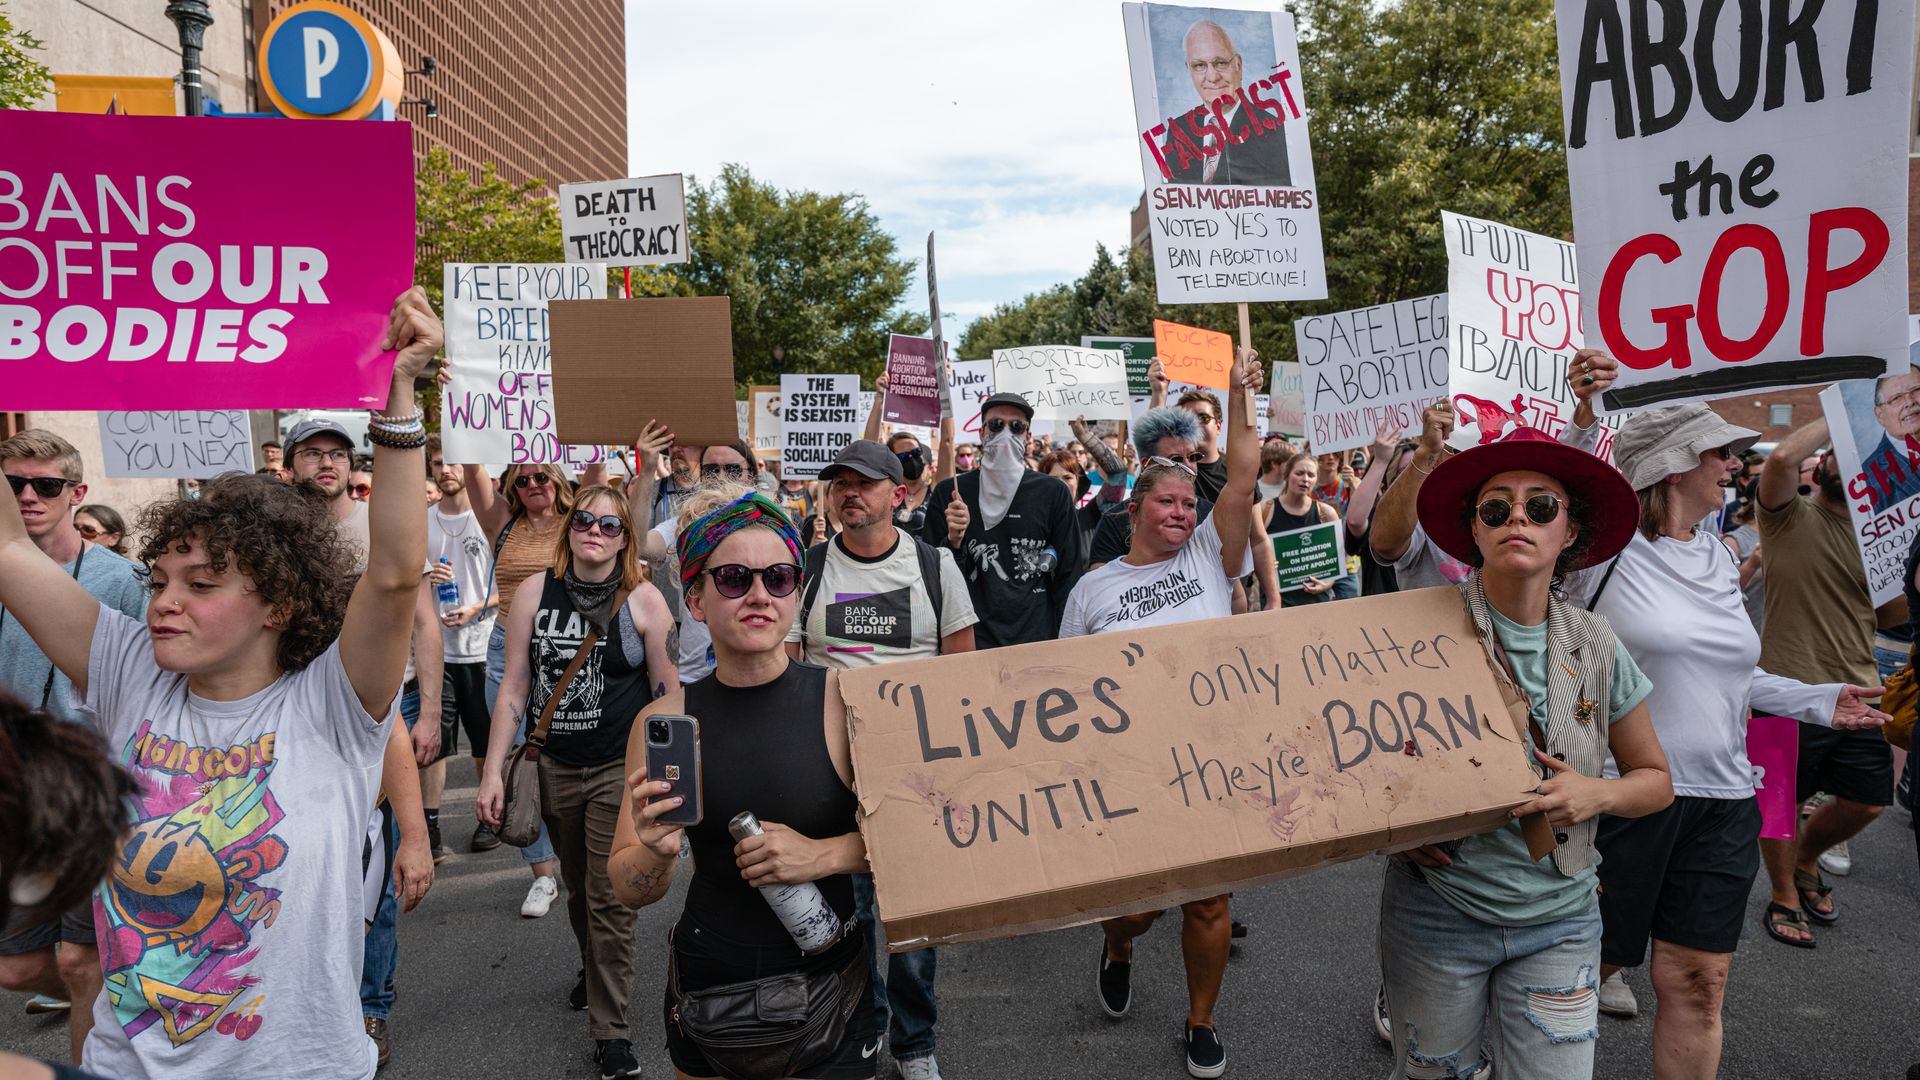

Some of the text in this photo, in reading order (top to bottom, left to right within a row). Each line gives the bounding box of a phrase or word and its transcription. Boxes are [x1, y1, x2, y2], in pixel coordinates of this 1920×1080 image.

[303, 27, 340, 99] P
[1142, 69, 1302, 180] FASCIST
[1153, 187, 1312, 210] SEN. MICHAEL NEMES
[1659, 153, 1780, 222] the
[0, 170, 196, 237] BANS
[575, 187, 656, 218] DEATH
[608, 216, 626, 226] TO
[1157, 211, 1297, 240] VOTED YES TO
[570, 224, 679, 259] THEOCRACY
[1457, 218, 1531, 271] PUT
[0, 237, 330, 304] OFF OUR
[1168, 247, 1297, 269] BAN ABORTION
[454, 265, 593, 301] KEEP YOUR
[1177, 270, 1307, 292] TELEMEDICINE!
[1598, 207, 1890, 370] GOP
[478, 308, 550, 341] BREED
[1390, 296, 1448, 350] LEG
[1487, 268, 1584, 352] YOU
[0, 304, 295, 364] BODIES
[1163, 324, 1221, 348] FUCK
[892, 364, 927, 376] ABORTION
[893, 353, 925, 365] BANNING
[996, 349, 1120, 369] ABORTION
[1459, 324, 1576, 407] BACK
[499, 370, 552, 396] OFF
[807, 378, 834, 391] THE
[890, 385, 939, 398] PREGNANCY
[891, 375, 936, 386] IS FORCING
[1046, 368, 1078, 387] IS
[1273, 365, 1303, 396] Man
[1313, 346, 1449, 411] ABORTIO
[449, 392, 550, 430] WOMENS
[791, 393, 850, 407] SYSTEM
[1021, 390, 1125, 408] EALTHCARE
[106, 409, 247, 439] COME FOR
[785, 409, 856, 423] IS SEXIST!
[1272, 401, 1304, 427] Vase
[1313, 413, 1331, 446] BY
[1335, 409, 1360, 441] ANY
[1363, 403, 1409, 436] MEANS
[788, 432, 852, 446] FIGHT FOR
[112, 439, 249, 471] YOU NEXT
[784, 449, 842, 463] SOCIALIS
[1847, 433, 1920, 513] SHA
[1861, 507, 1905, 547] SEN
[1282, 542, 1332, 558] FREE ABORTION
[1301, 552, 1327, 562] DEMAND
[1865, 528, 1914, 564] STOOD
[1279, 558, 1337, 575] WITHOUT APOLOGY
[1120, 570, 1187, 604] ABORTION
[535, 609, 607, 639] C.L.A..
[844, 616, 897, 625] OFF OUR
[845, 606, 877, 616] BANS
[845, 625, 892, 634] BODIES
[1190, 647, 1281, 708] only
[552, 720, 598, 730] SUPREMACY
[567, 709, 602, 720] AGAINST
[943, 779, 1139, 849] UNTIL
[1323, 691, 1482, 772] BORN
